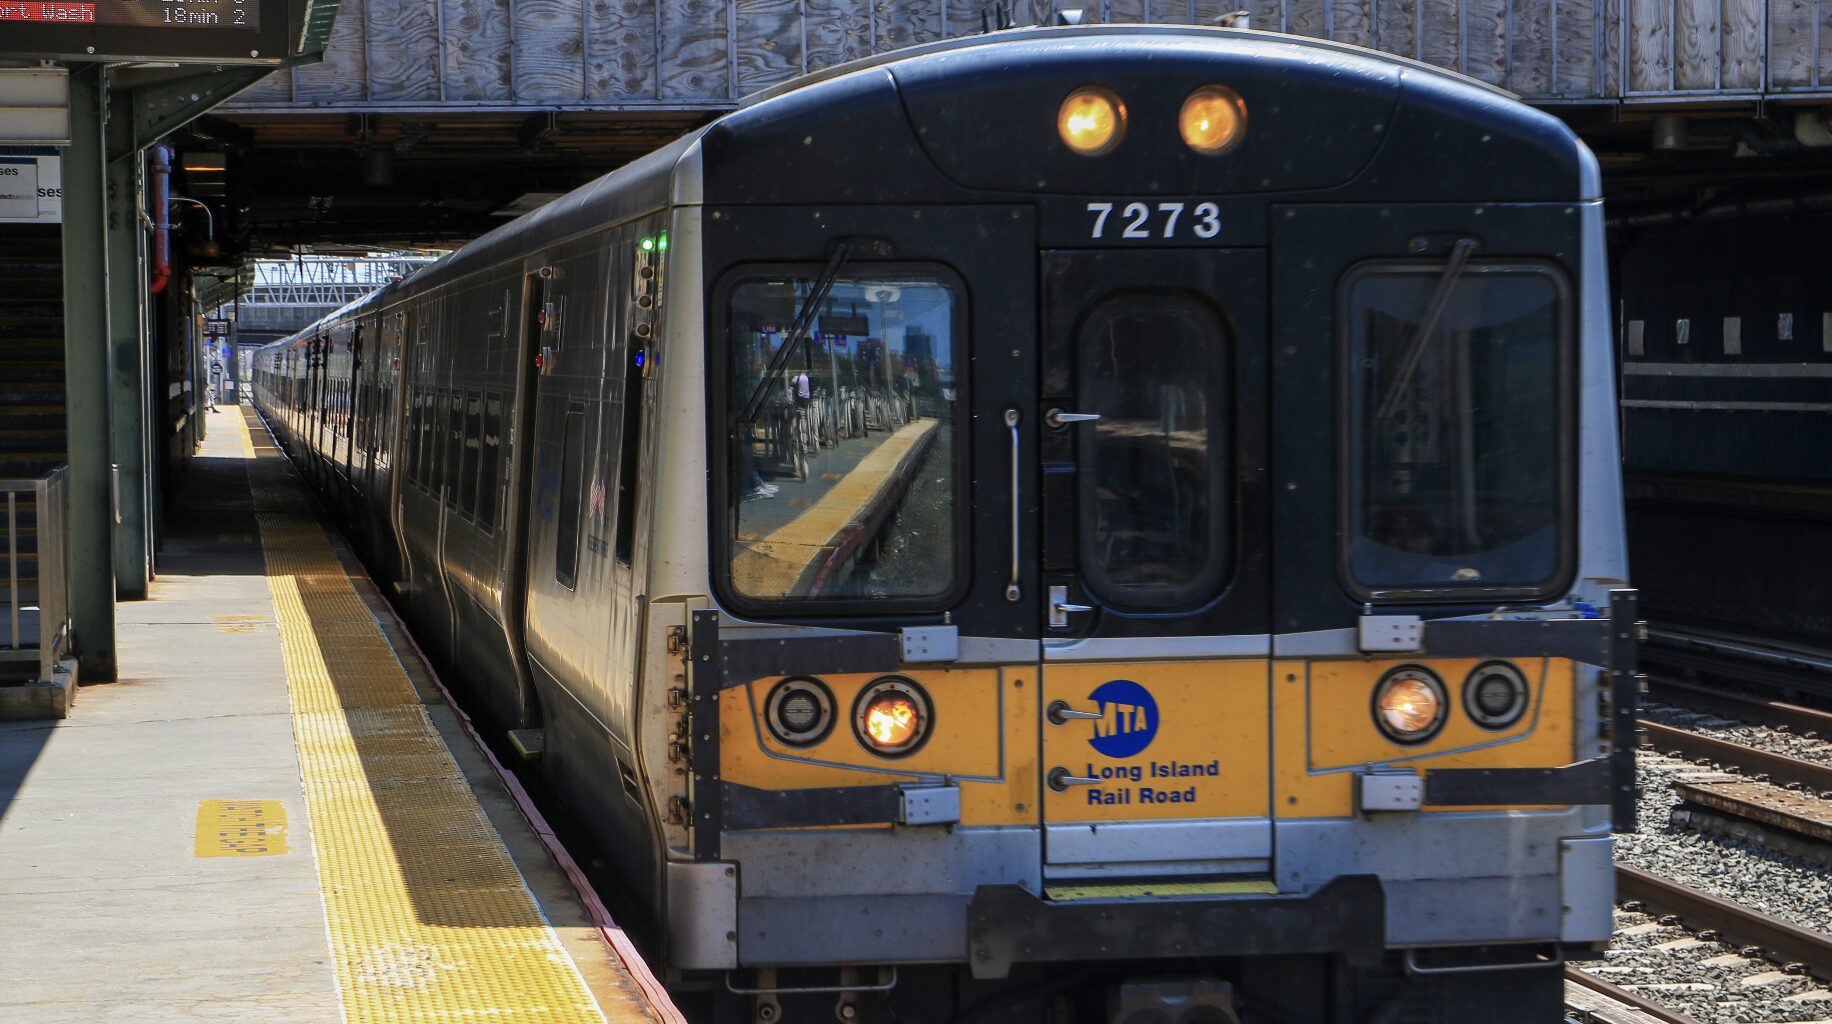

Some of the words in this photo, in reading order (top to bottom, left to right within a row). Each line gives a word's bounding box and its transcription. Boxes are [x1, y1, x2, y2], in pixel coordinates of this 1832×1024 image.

[42, 4, 94, 20] Wash
[164, 8, 218, 23] 18min
[233, 9, 245, 24] 2
[1087, 202, 1221, 238] 7273
[1088, 700, 1148, 740] MTA
[1087, 763, 1142, 782] Long
[1151, 760, 1220, 778] Island
[1087, 788, 1130, 805] Rail
[1139, 786, 1196, 804] Road
